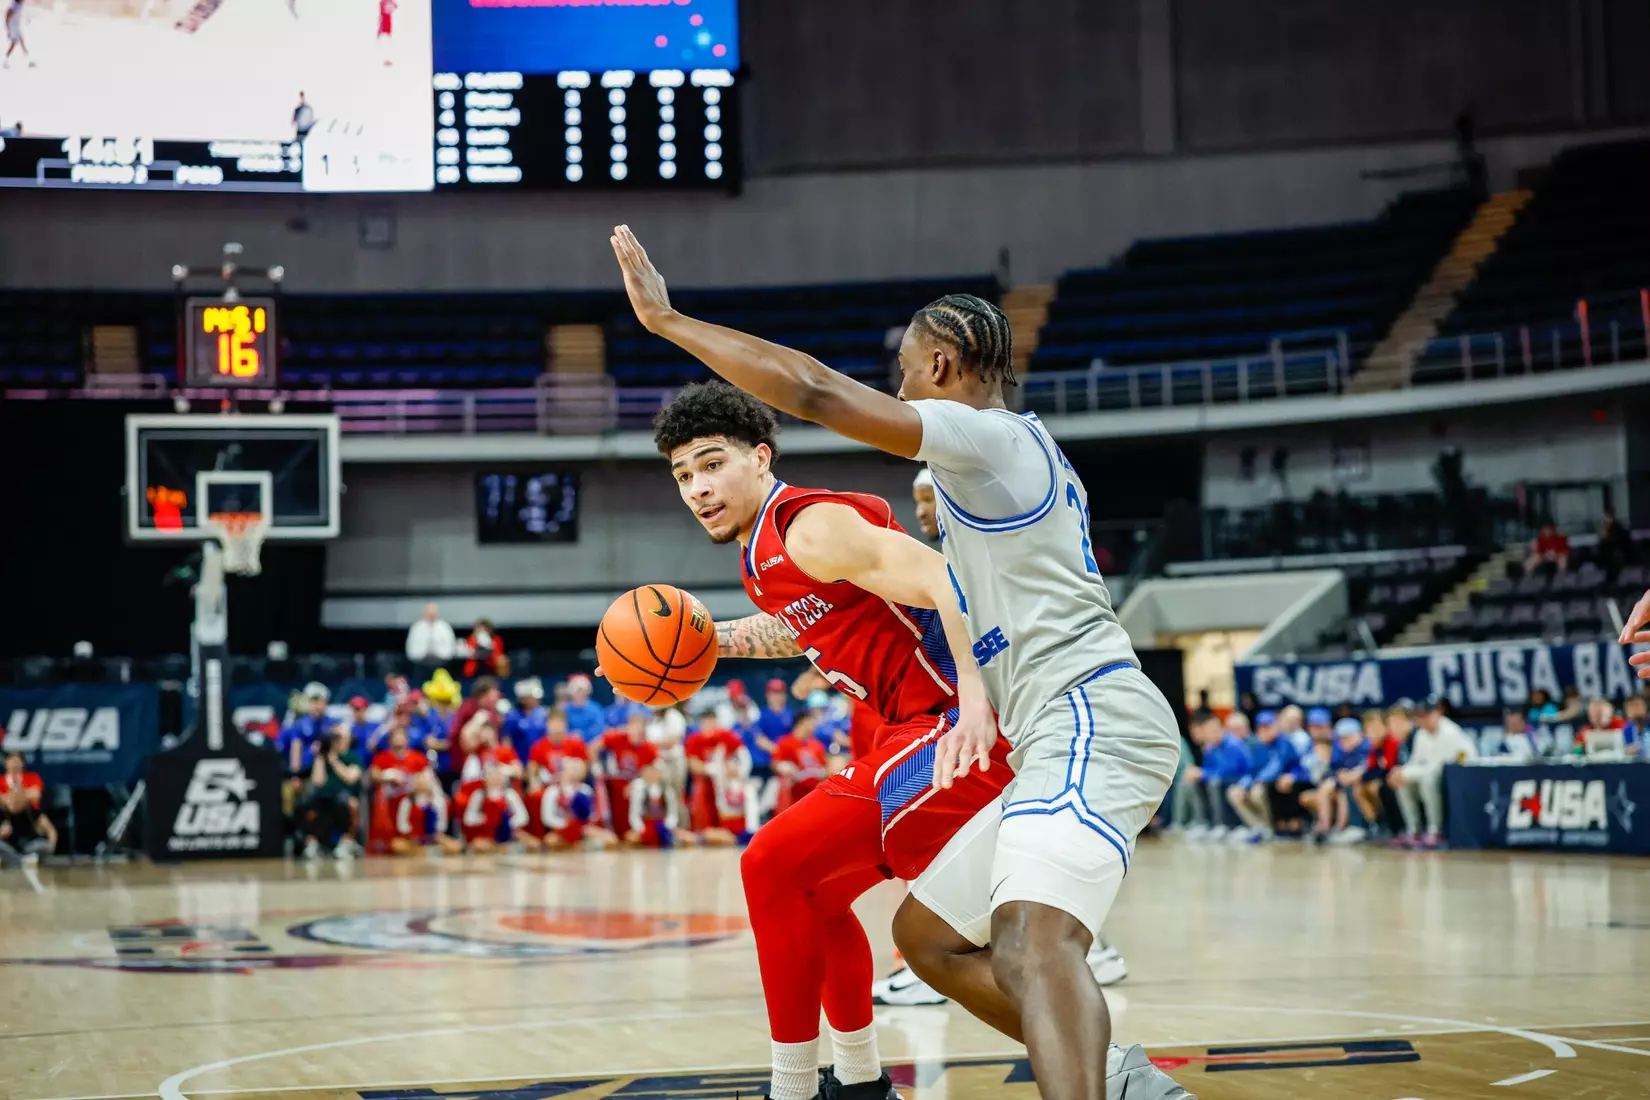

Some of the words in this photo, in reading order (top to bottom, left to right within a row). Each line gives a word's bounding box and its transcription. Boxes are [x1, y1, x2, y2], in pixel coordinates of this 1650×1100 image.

[218, 331, 259, 378] 16
[972, 625, 1010, 667] SEE
[1429, 644, 1563, 708] CUSA
[172, 801, 261, 836] USA
